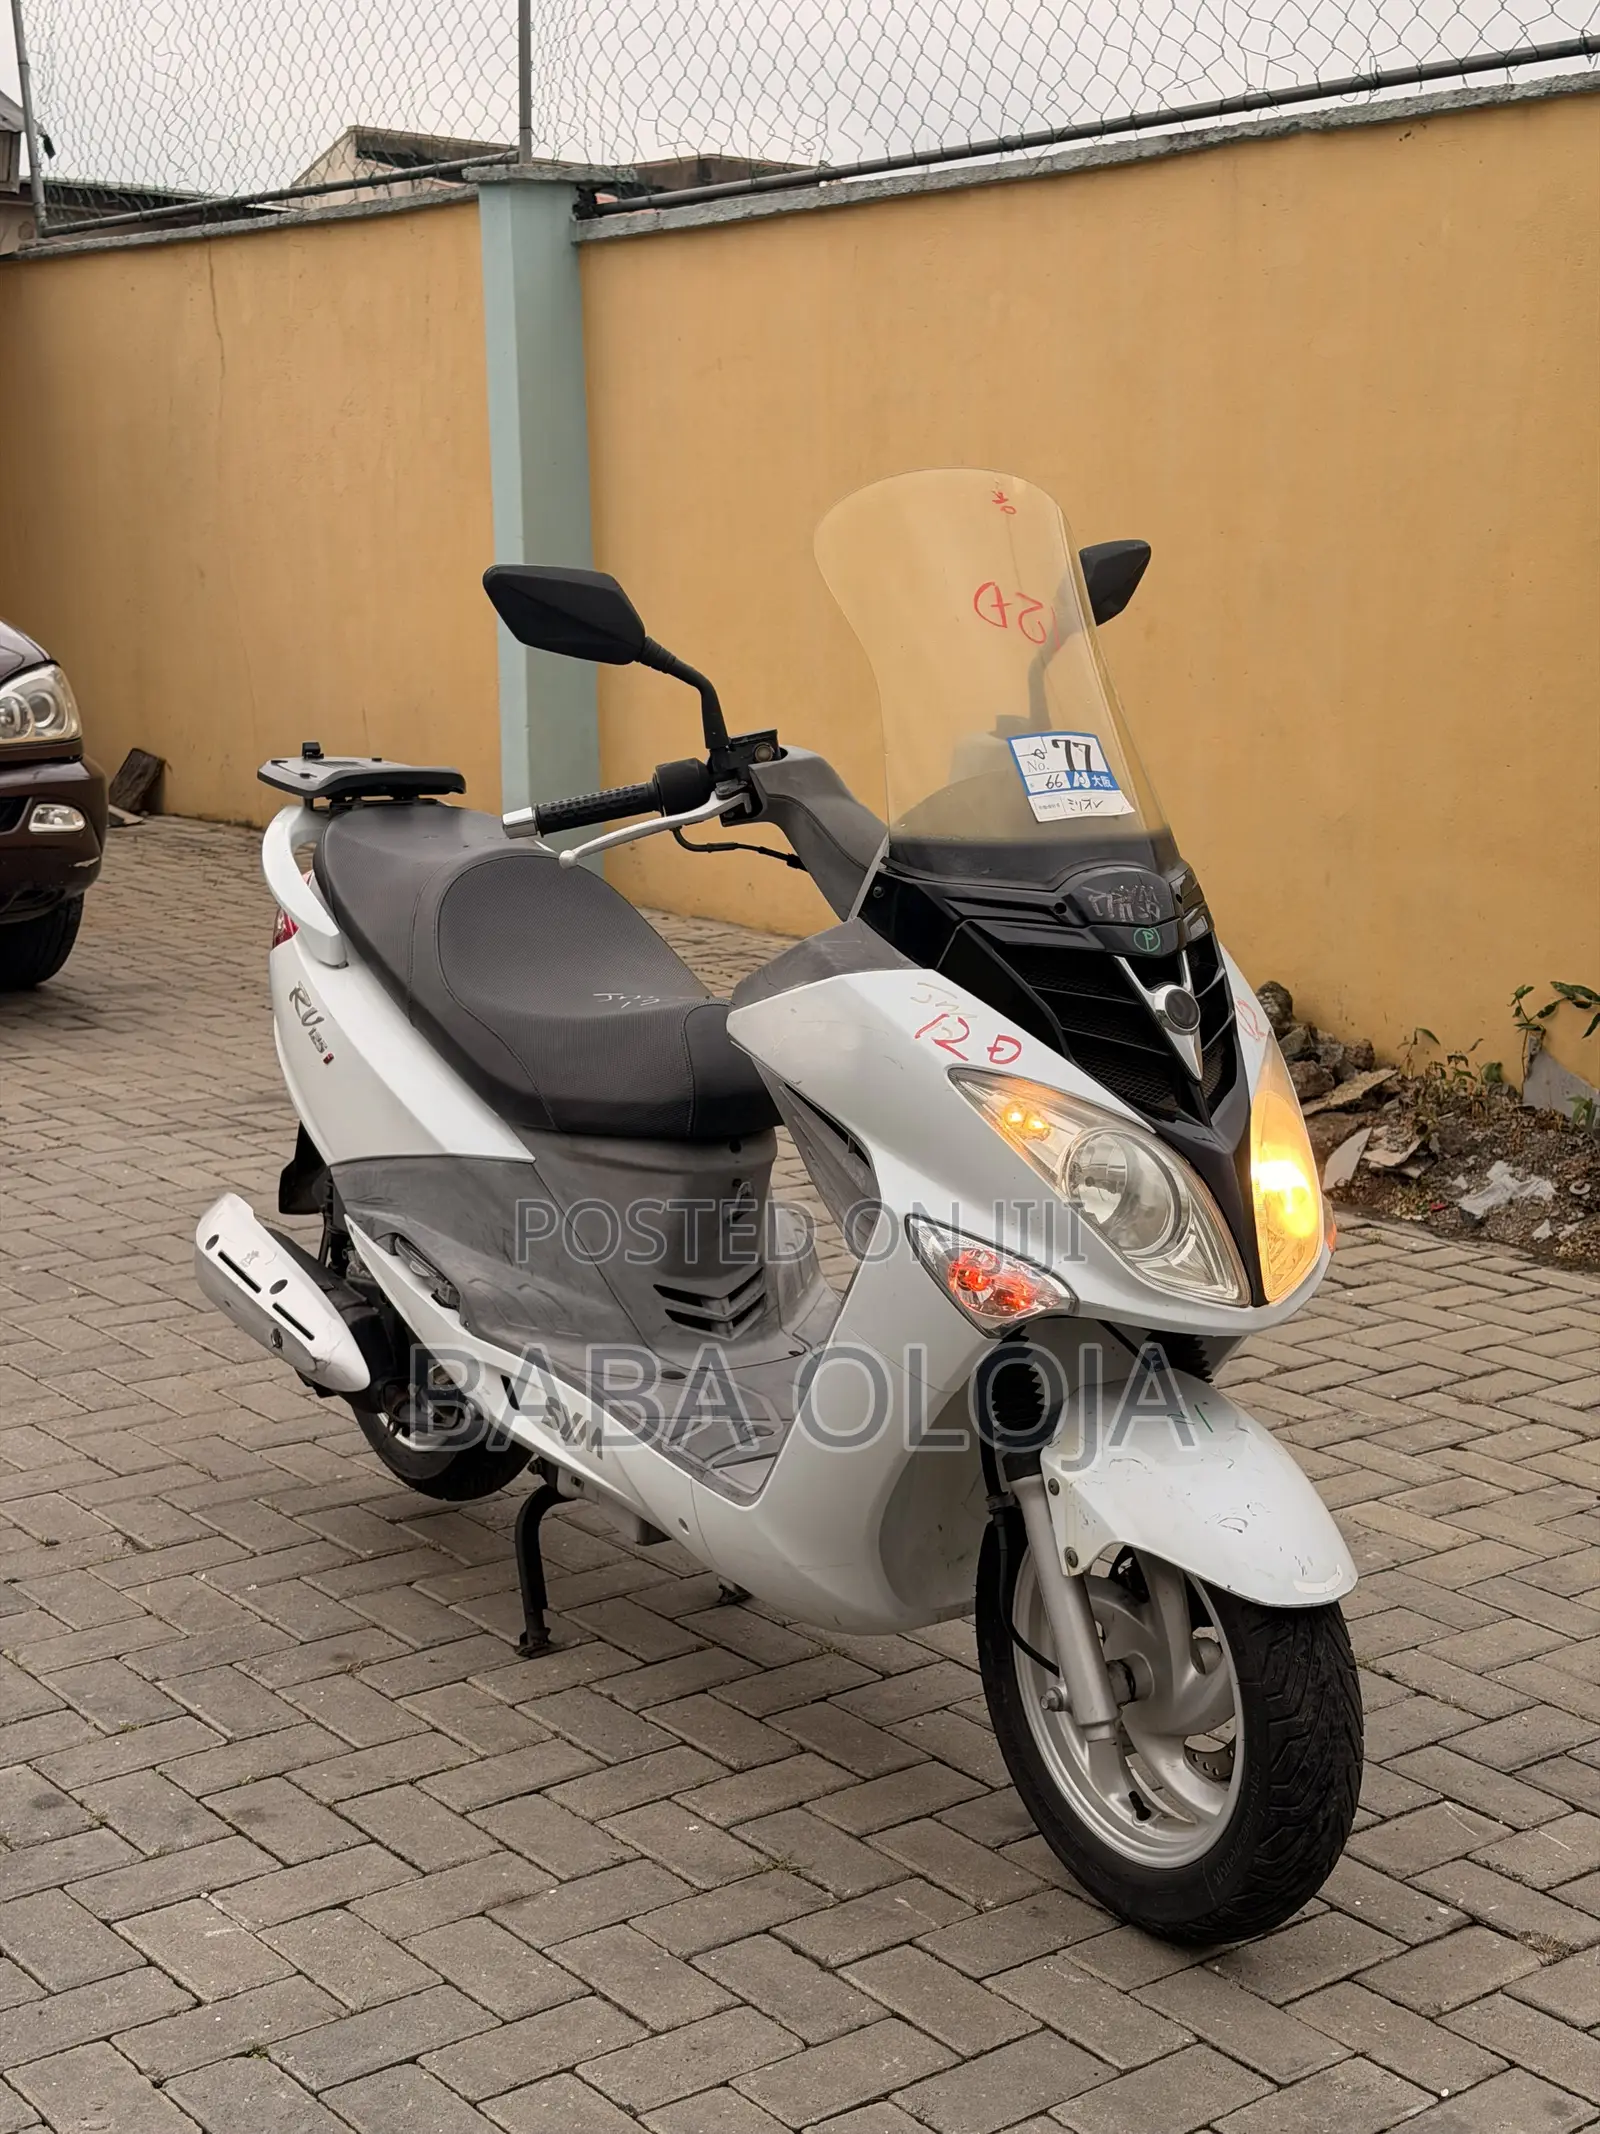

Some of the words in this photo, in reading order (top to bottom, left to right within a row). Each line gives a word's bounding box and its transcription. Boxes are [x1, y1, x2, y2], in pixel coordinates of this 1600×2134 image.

[1027, 759, 1051, 773] No.
[1045, 773, 1064, 789] 66
[1091, 775, 1114, 788] 大阪
